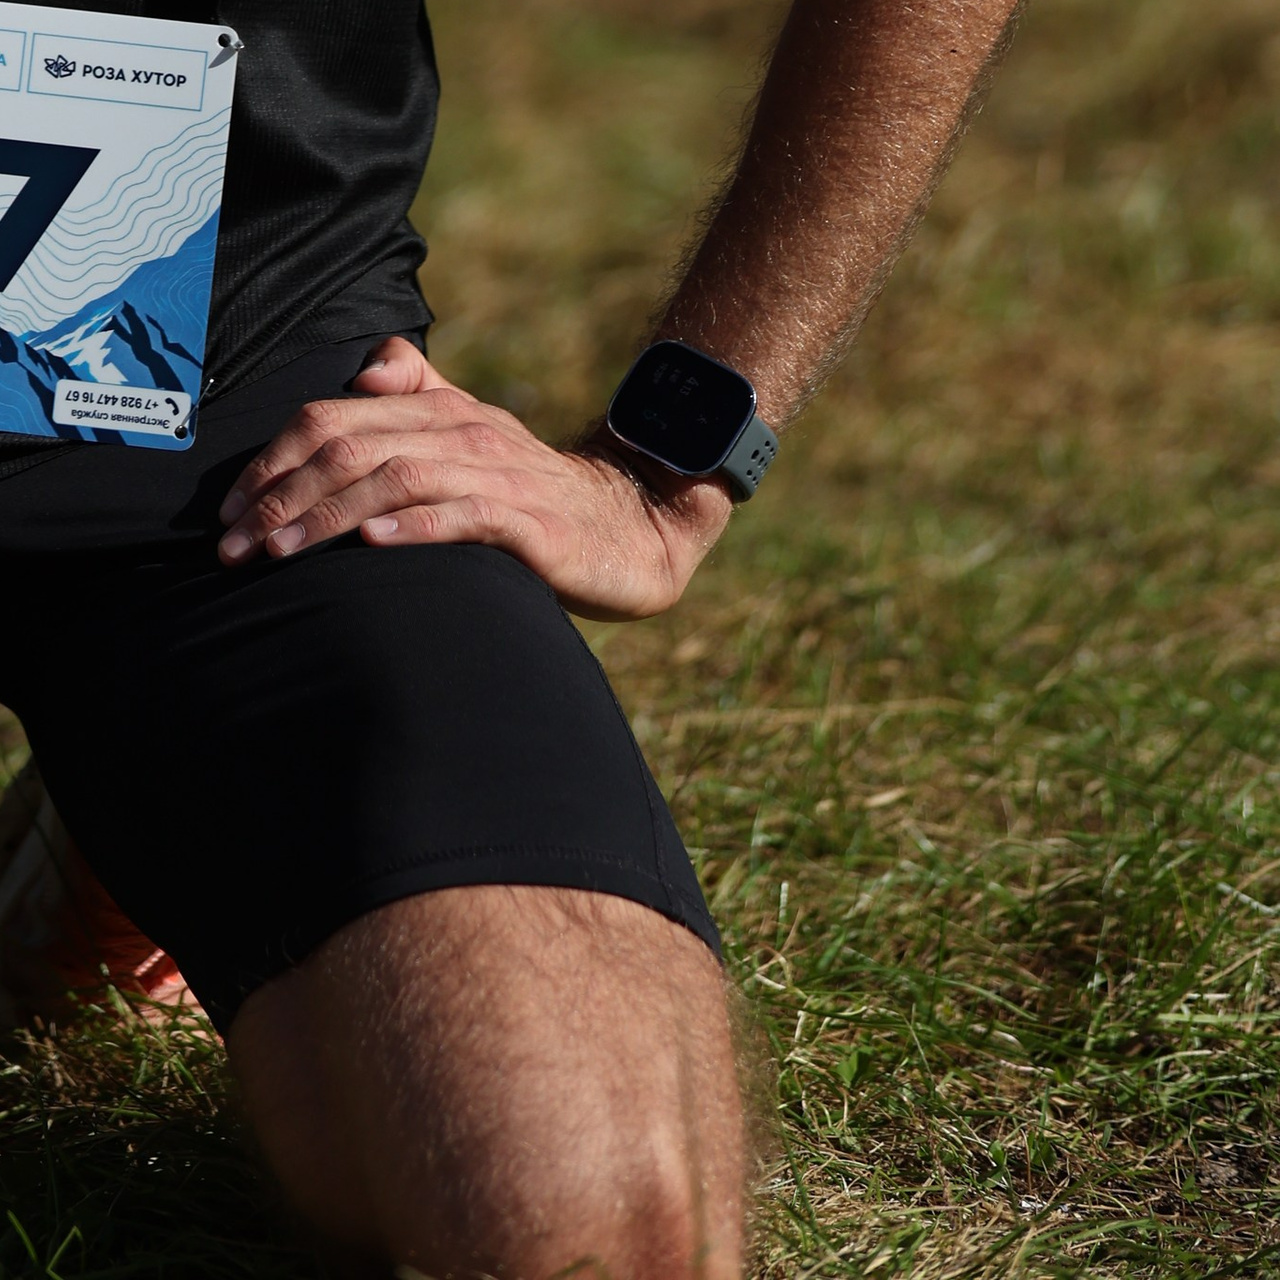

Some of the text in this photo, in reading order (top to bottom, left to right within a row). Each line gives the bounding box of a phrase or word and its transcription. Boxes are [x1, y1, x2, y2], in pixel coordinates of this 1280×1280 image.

[81, 64, 187, 88] РОЗА ХУТОР
[65, 389, 159, 410] +7 928 447 16 67
[70, 408, 170, 430] Экстренная служба
